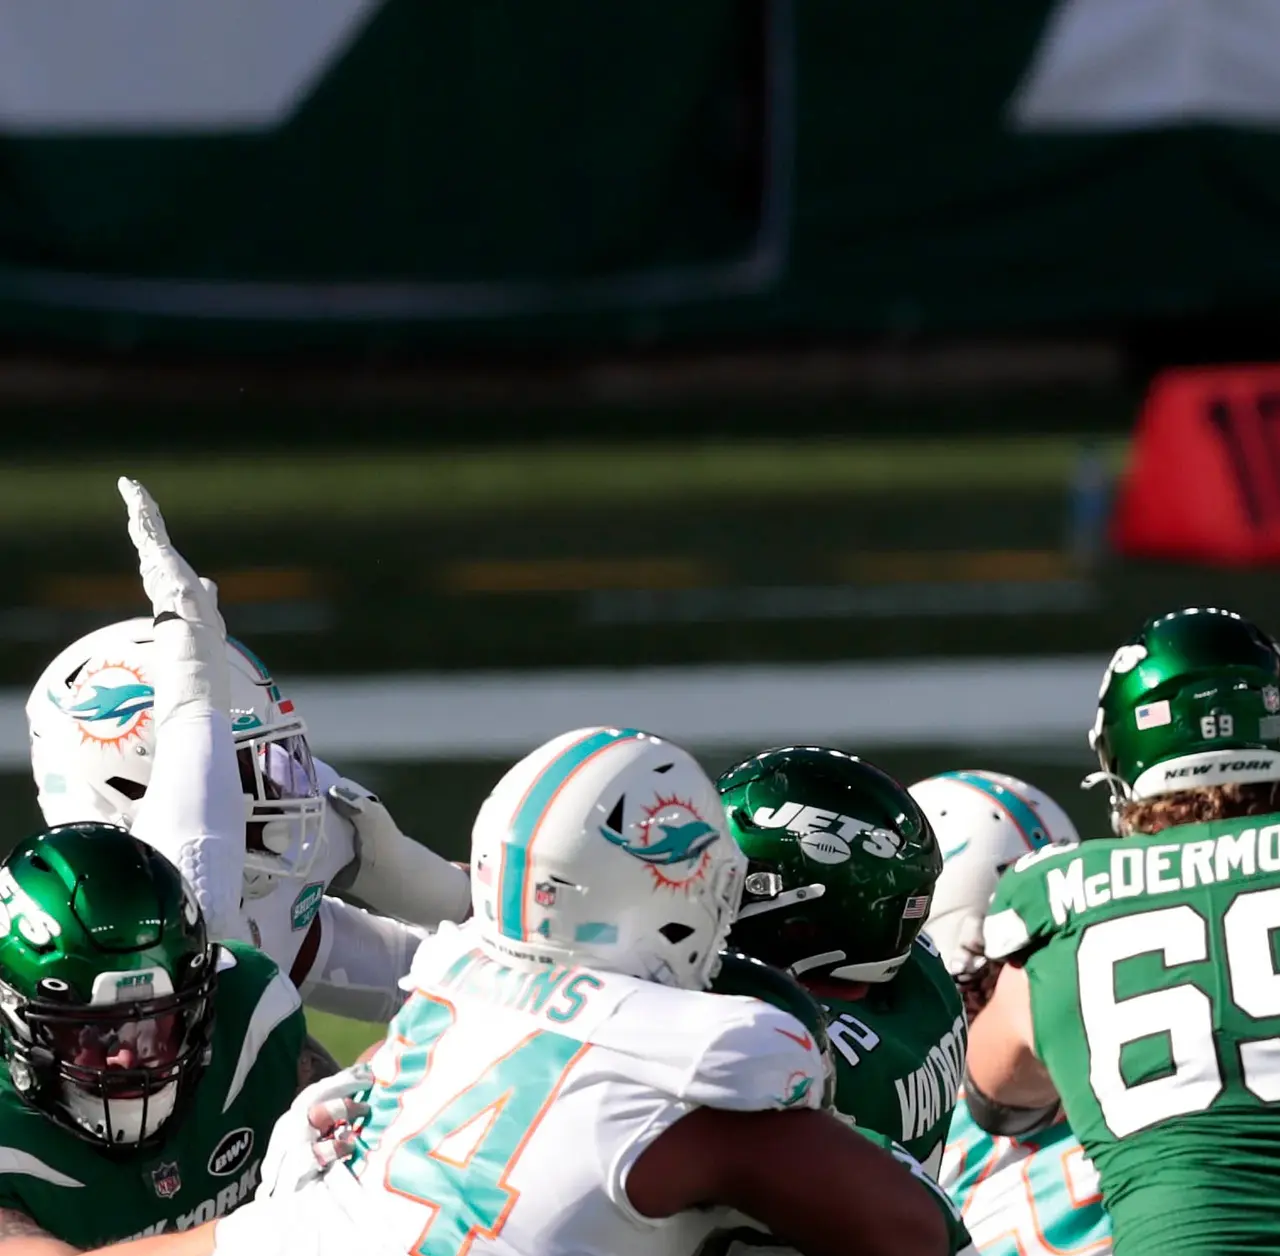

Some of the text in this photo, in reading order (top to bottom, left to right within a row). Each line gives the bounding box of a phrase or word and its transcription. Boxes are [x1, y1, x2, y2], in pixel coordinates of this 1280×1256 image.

[1201, 714, 1233, 739] 69
[1164, 759, 1274, 780] NEW YORK
[753, 802, 902, 859] JETS
[214, 1131, 250, 1173] BWJ
